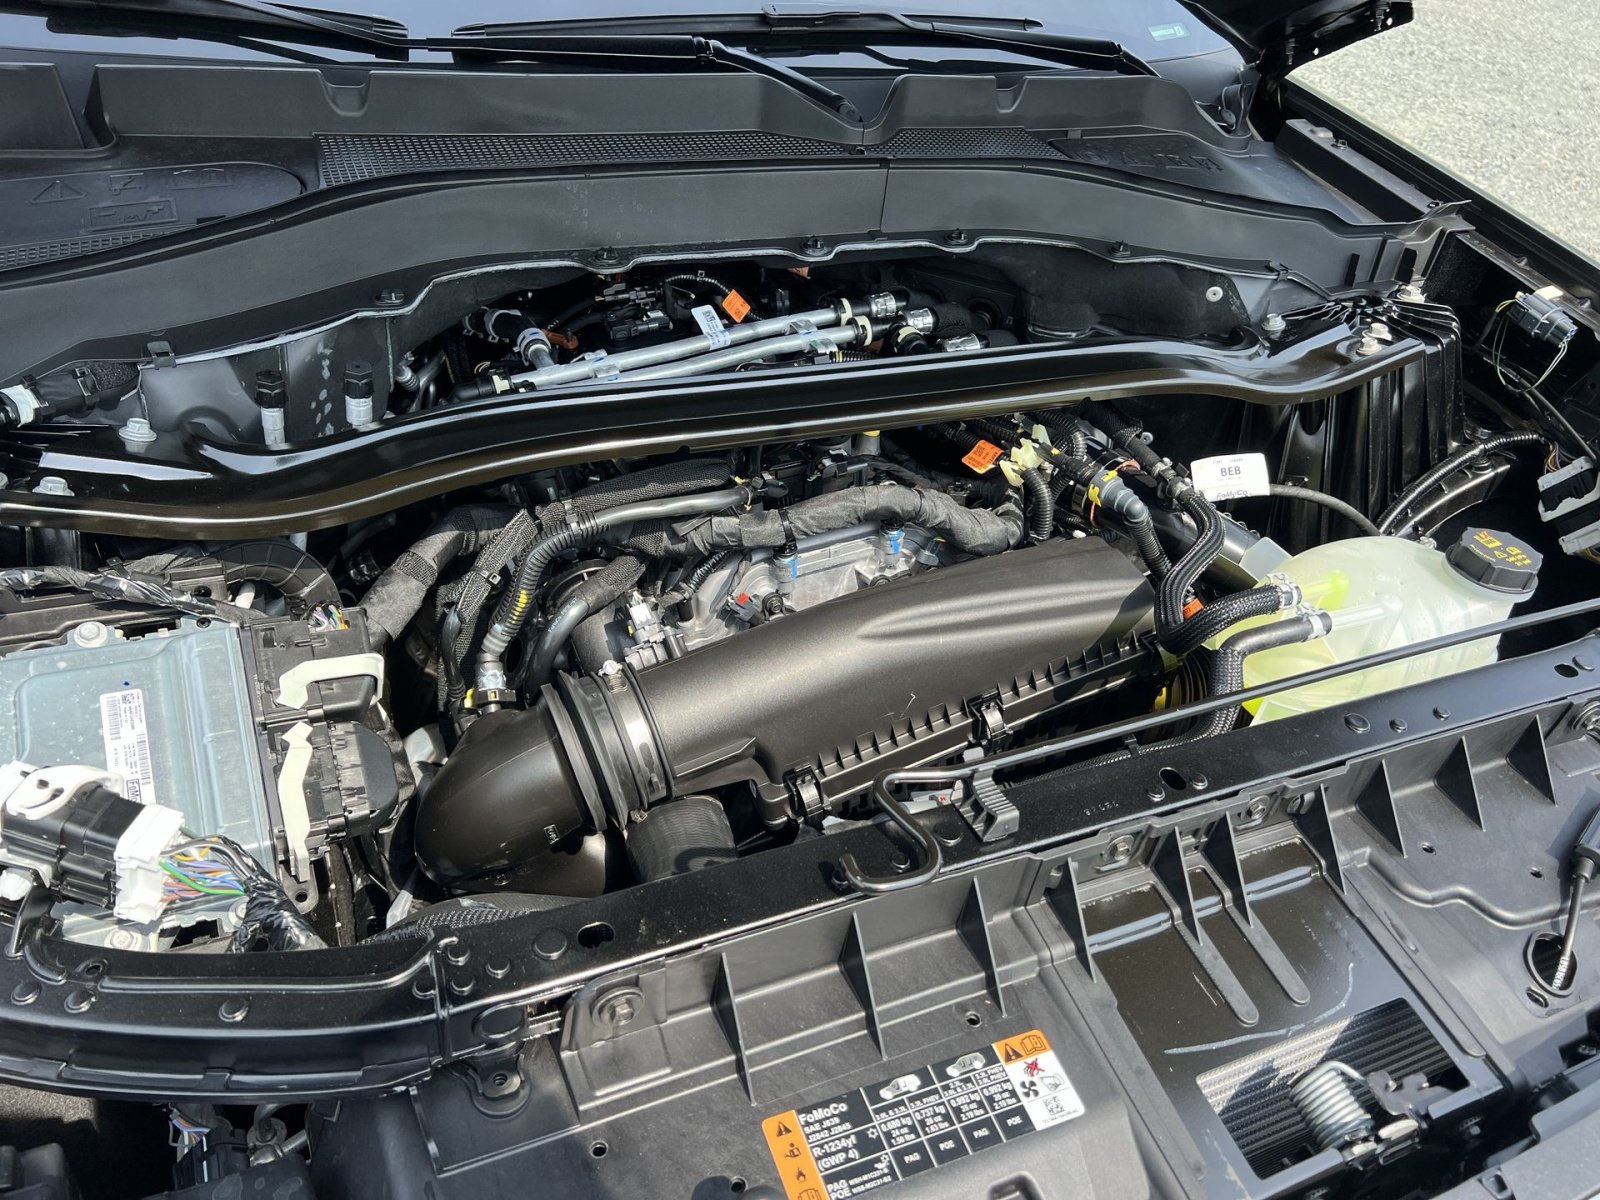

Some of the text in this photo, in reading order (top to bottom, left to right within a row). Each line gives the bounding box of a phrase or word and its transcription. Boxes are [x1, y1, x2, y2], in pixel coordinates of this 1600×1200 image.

[1220, 466, 1241, 476] BEB
[982, 1081, 1013, 1096] 0.992 kg
[949, 1092, 980, 1107] 0.992 kg
[1005, 1097, 1016, 1105] lbs
[797, 1102, 847, 1125] FoMoCo
[914, 1104, 946, 1120] 0.737 kg
[972, 1108, 984, 1116] lbs
[899, 1116, 912, 1125] kg
[937, 1121, 949, 1129] lbs
[1006, 1115, 1022, 1126] POE
[803, 1122, 821, 1133] SAE
[890, 1126, 909, 1137] 24 oz
[972, 1127, 989, 1138] PAG
[903, 1133, 915, 1141] lbs
[811, 1134, 856, 1157] R-1234yf
[938, 1139, 954, 1150] POE
[817, 1148, 859, 1171] (GWP 4)
[903, 1152, 920, 1163] PAG
[826, 1179, 848, 1193] PAG
[829, 1186, 851, 1200] POE
